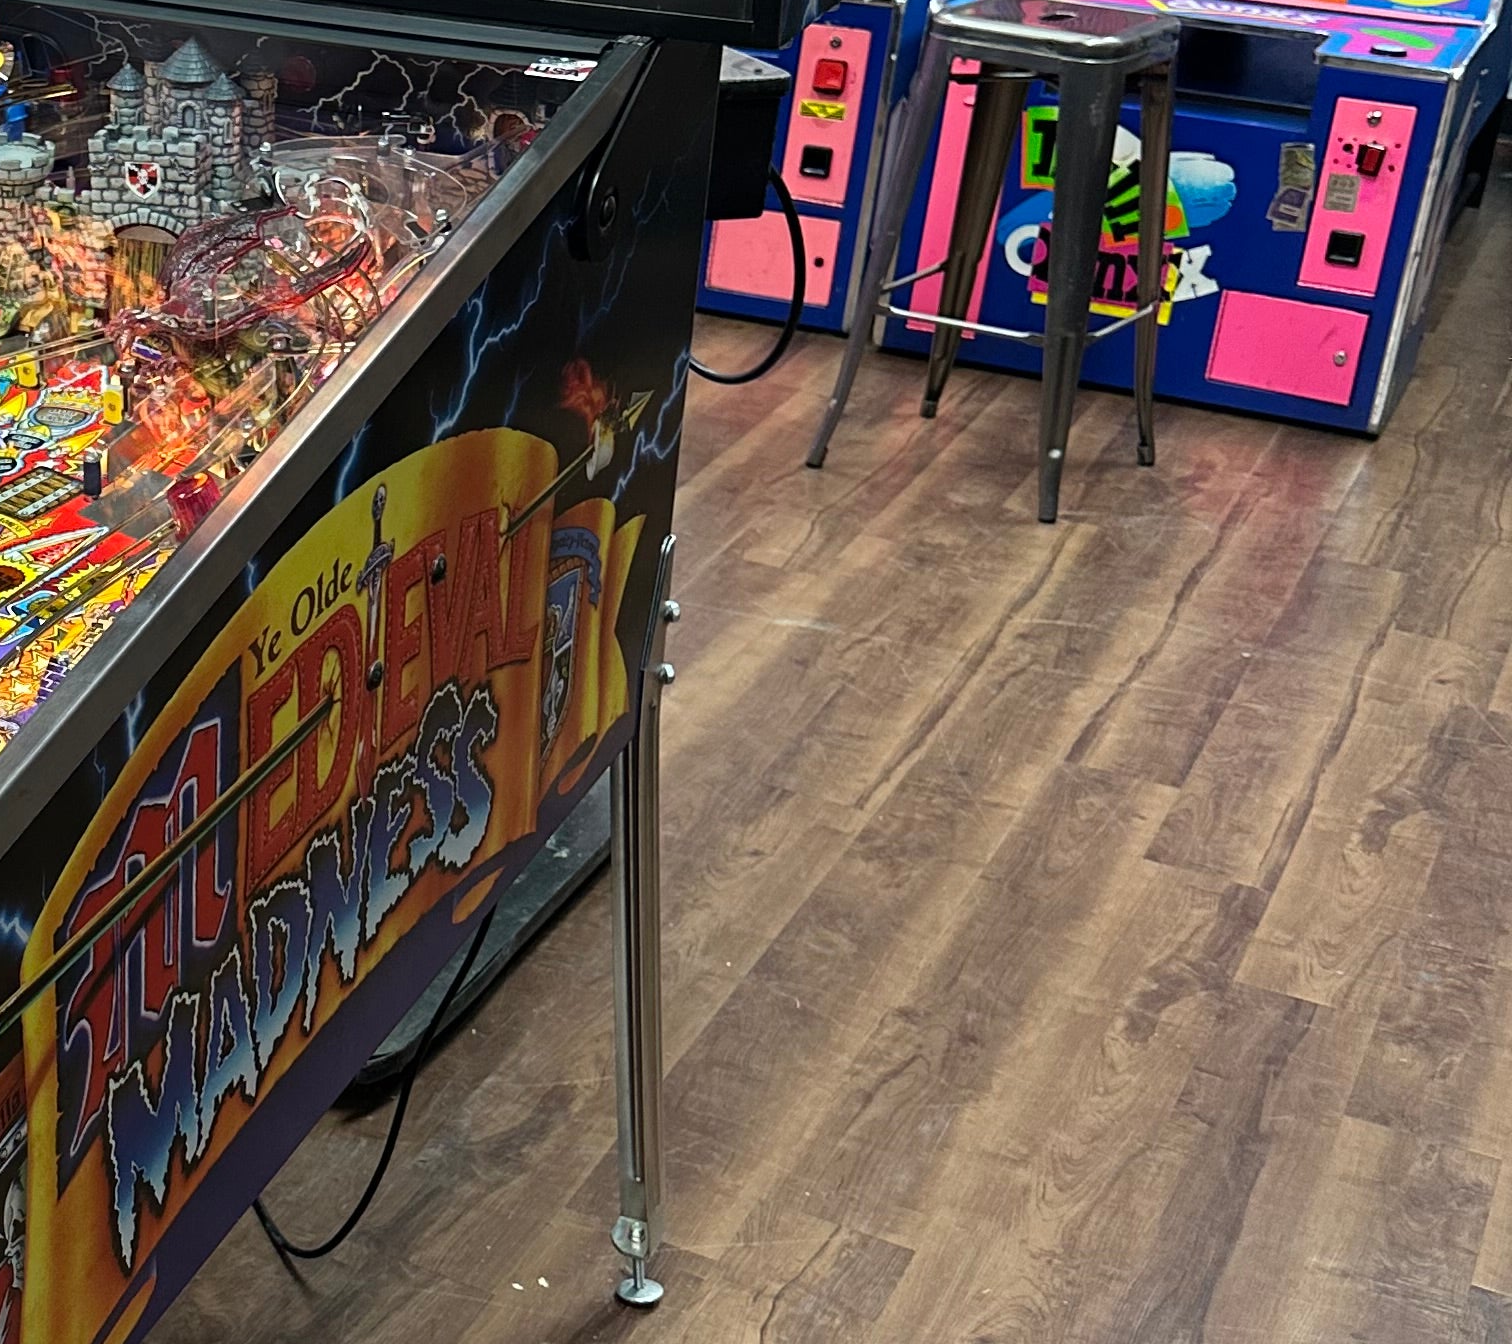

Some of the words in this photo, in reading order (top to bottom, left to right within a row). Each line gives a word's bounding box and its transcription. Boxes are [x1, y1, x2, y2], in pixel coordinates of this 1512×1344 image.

[247, 624, 282, 679] Ye
[290, 558, 353, 637] Olde
[105, 679, 498, 1270] MADNESS
